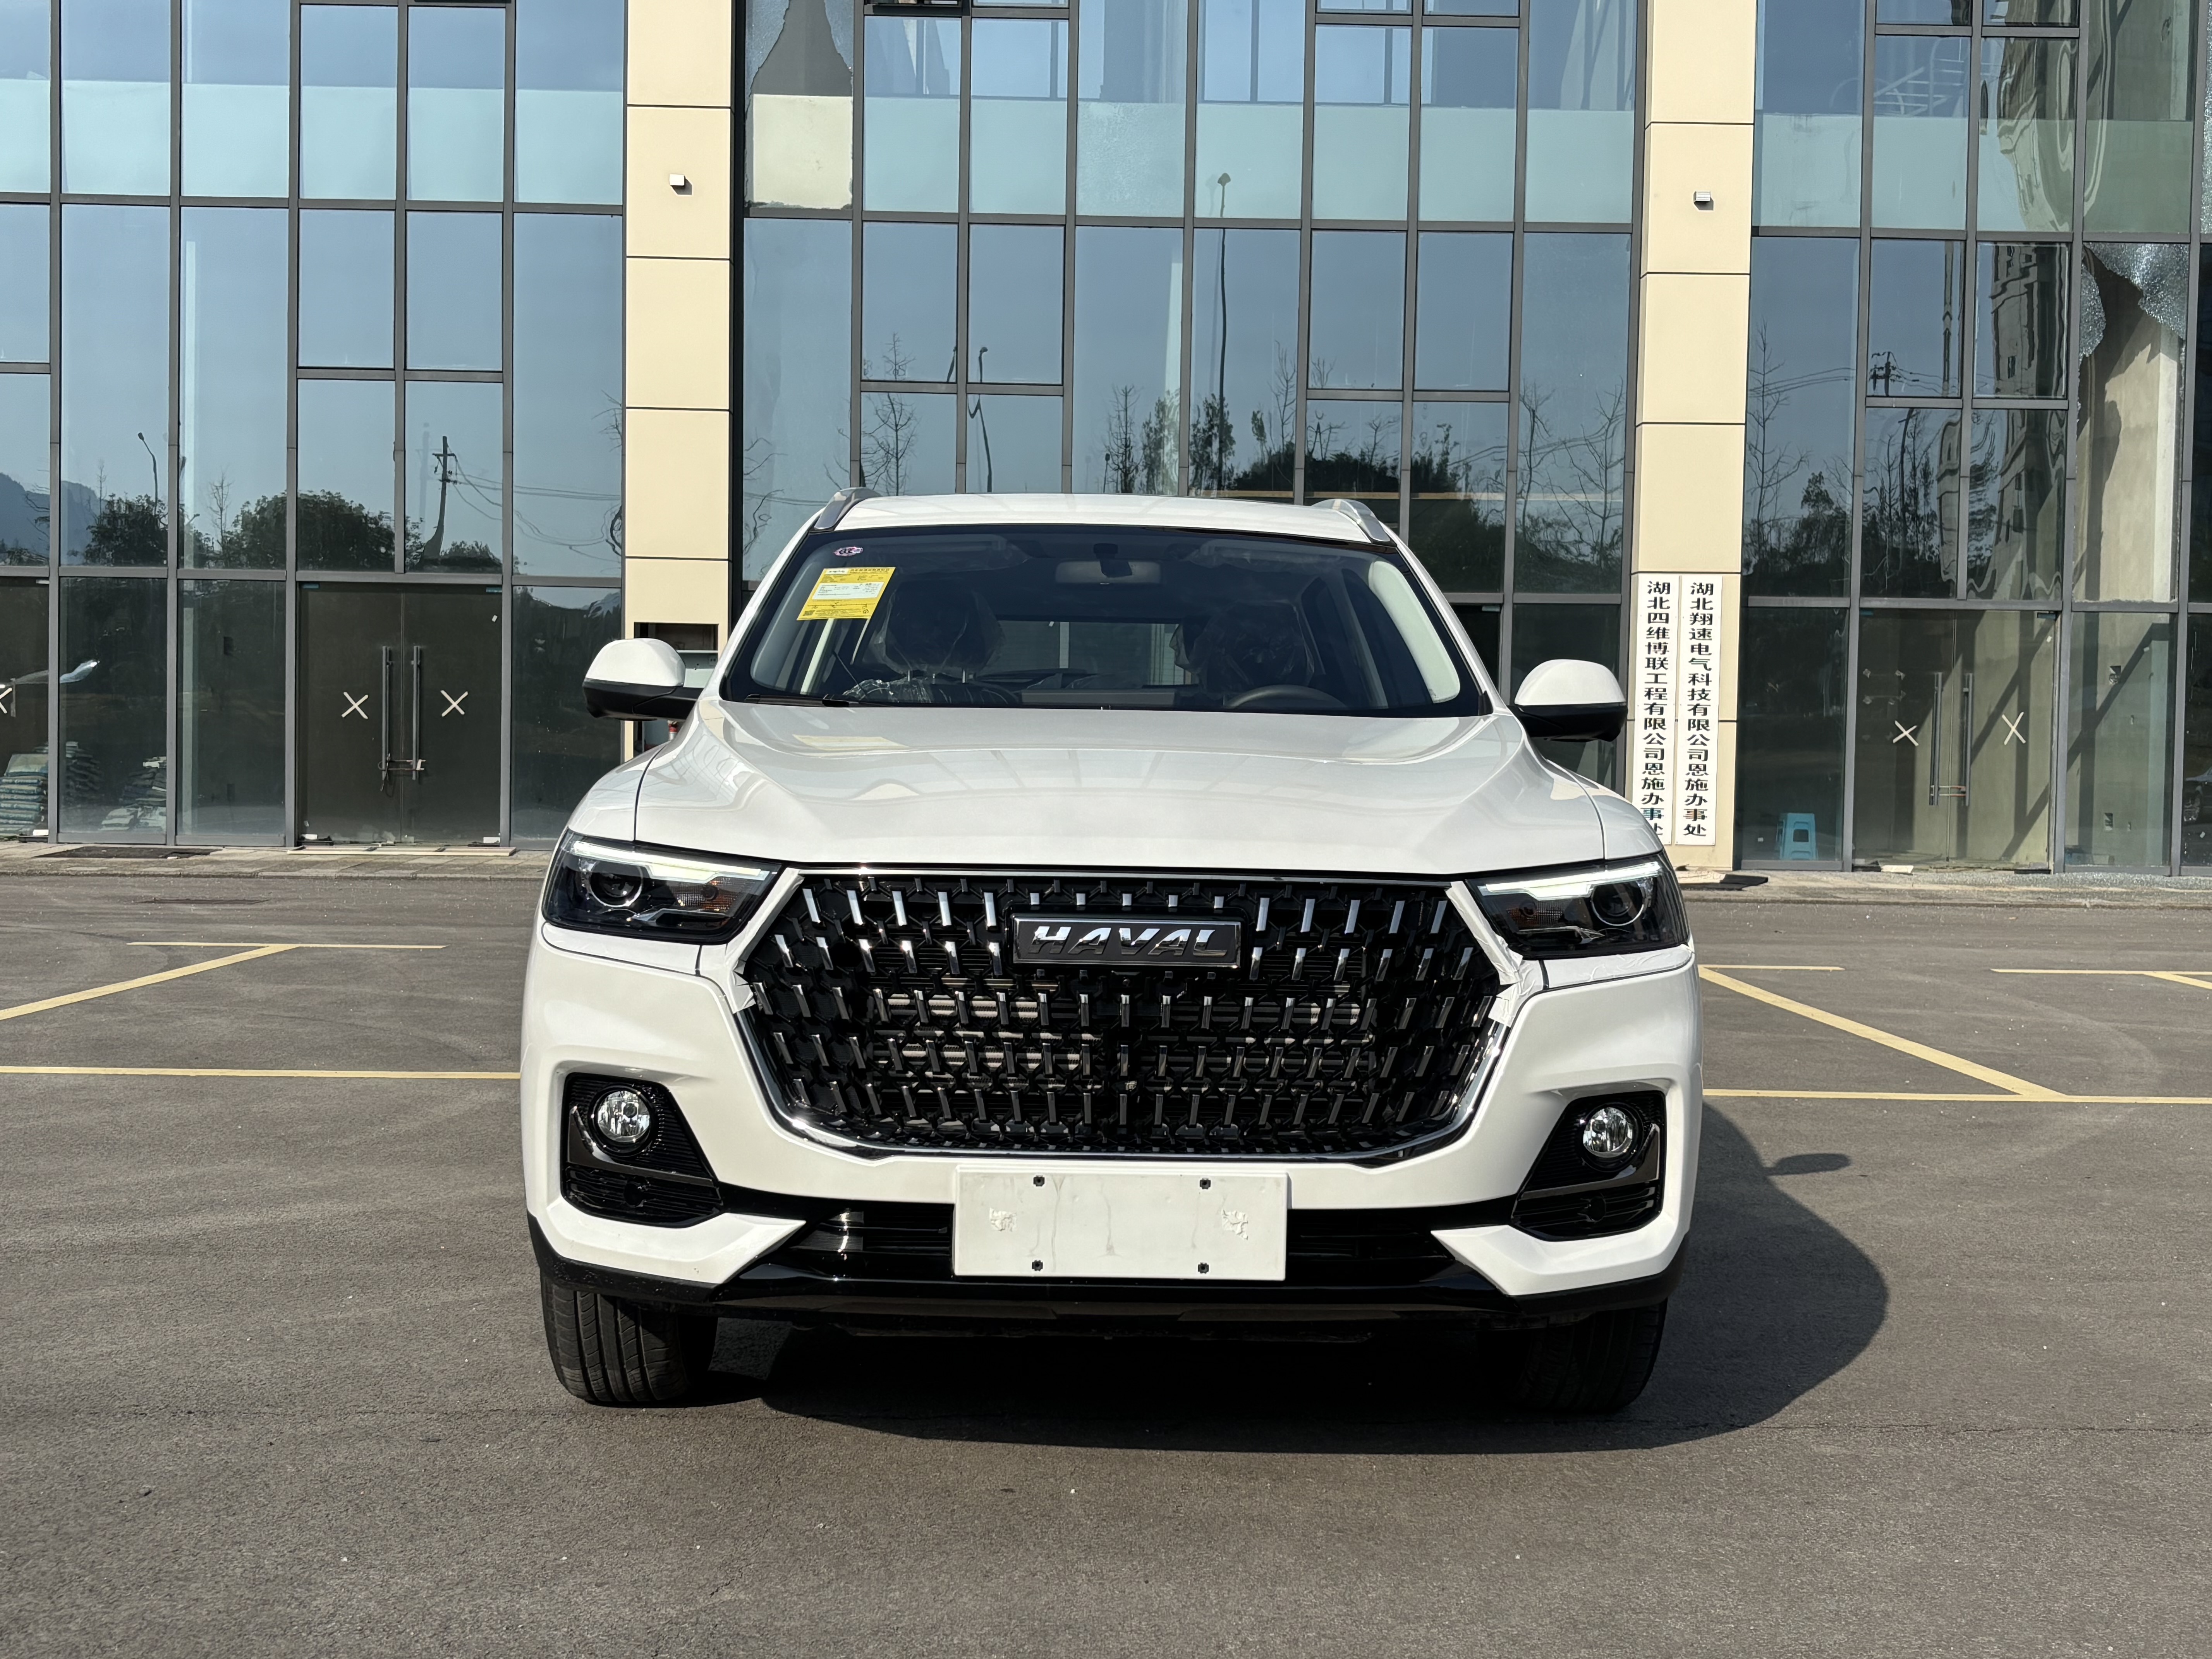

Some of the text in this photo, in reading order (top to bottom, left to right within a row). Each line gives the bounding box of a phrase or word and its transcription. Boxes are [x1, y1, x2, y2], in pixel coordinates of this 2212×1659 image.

[1683, 582, 1714, 836] 湖北翔速电气科技有限公司恩施办事处
[1028, 926, 1227, 957] HAVAL
